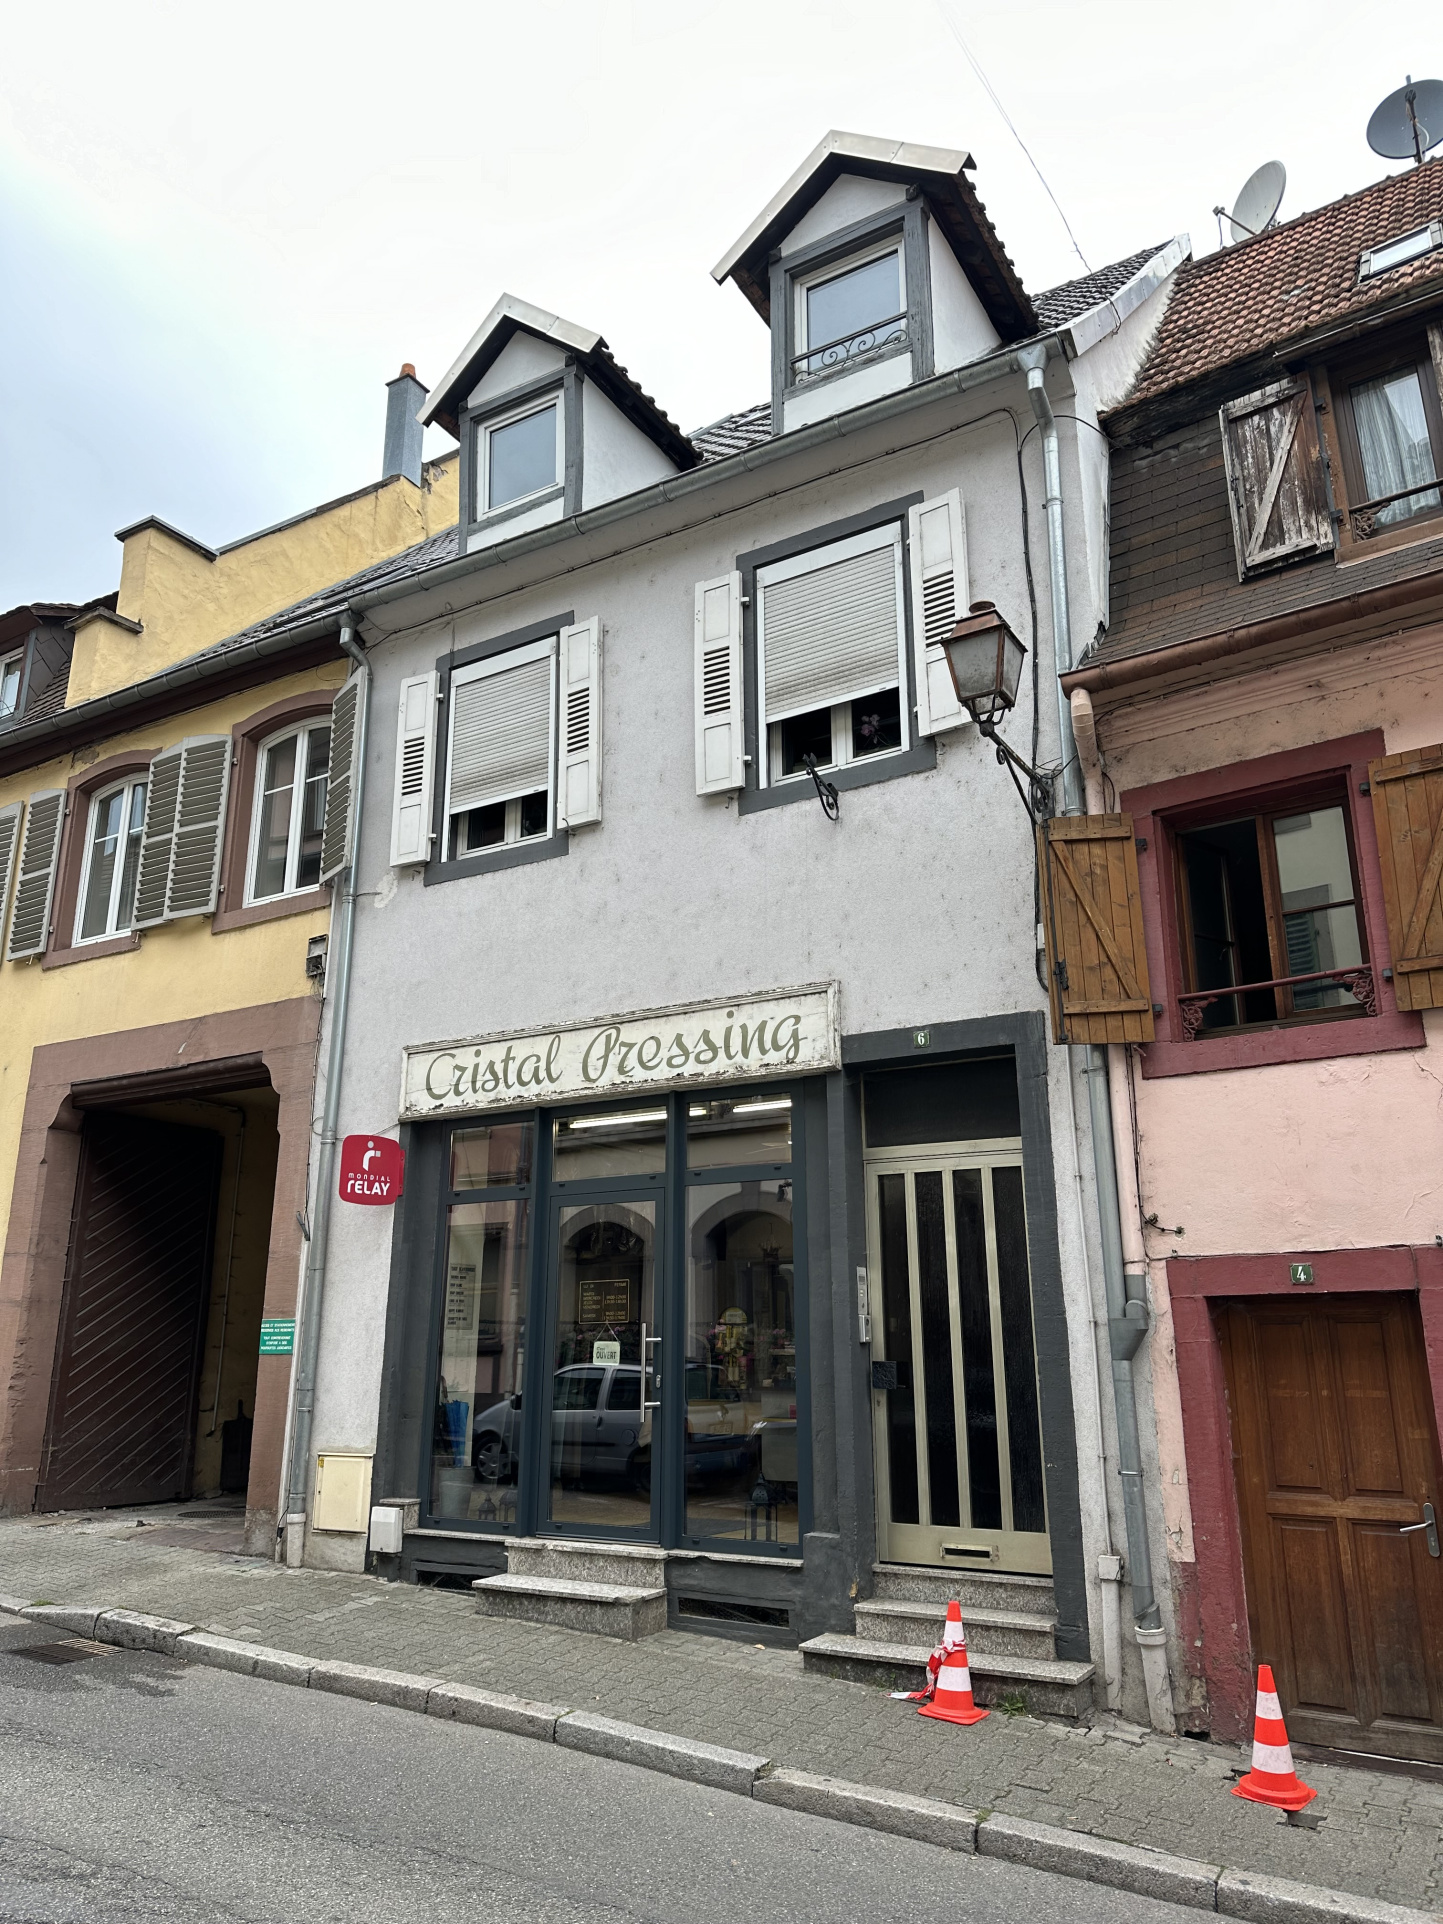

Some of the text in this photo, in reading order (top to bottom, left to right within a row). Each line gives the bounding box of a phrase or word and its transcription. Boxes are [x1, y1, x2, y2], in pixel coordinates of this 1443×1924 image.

[917, 1032, 925, 1046] 6
[425, 1009, 809, 1101] Cristal Pressing
[1296, 1265, 1307, 1282] 4
[596, 1351, 617, 1360] OUVERT
